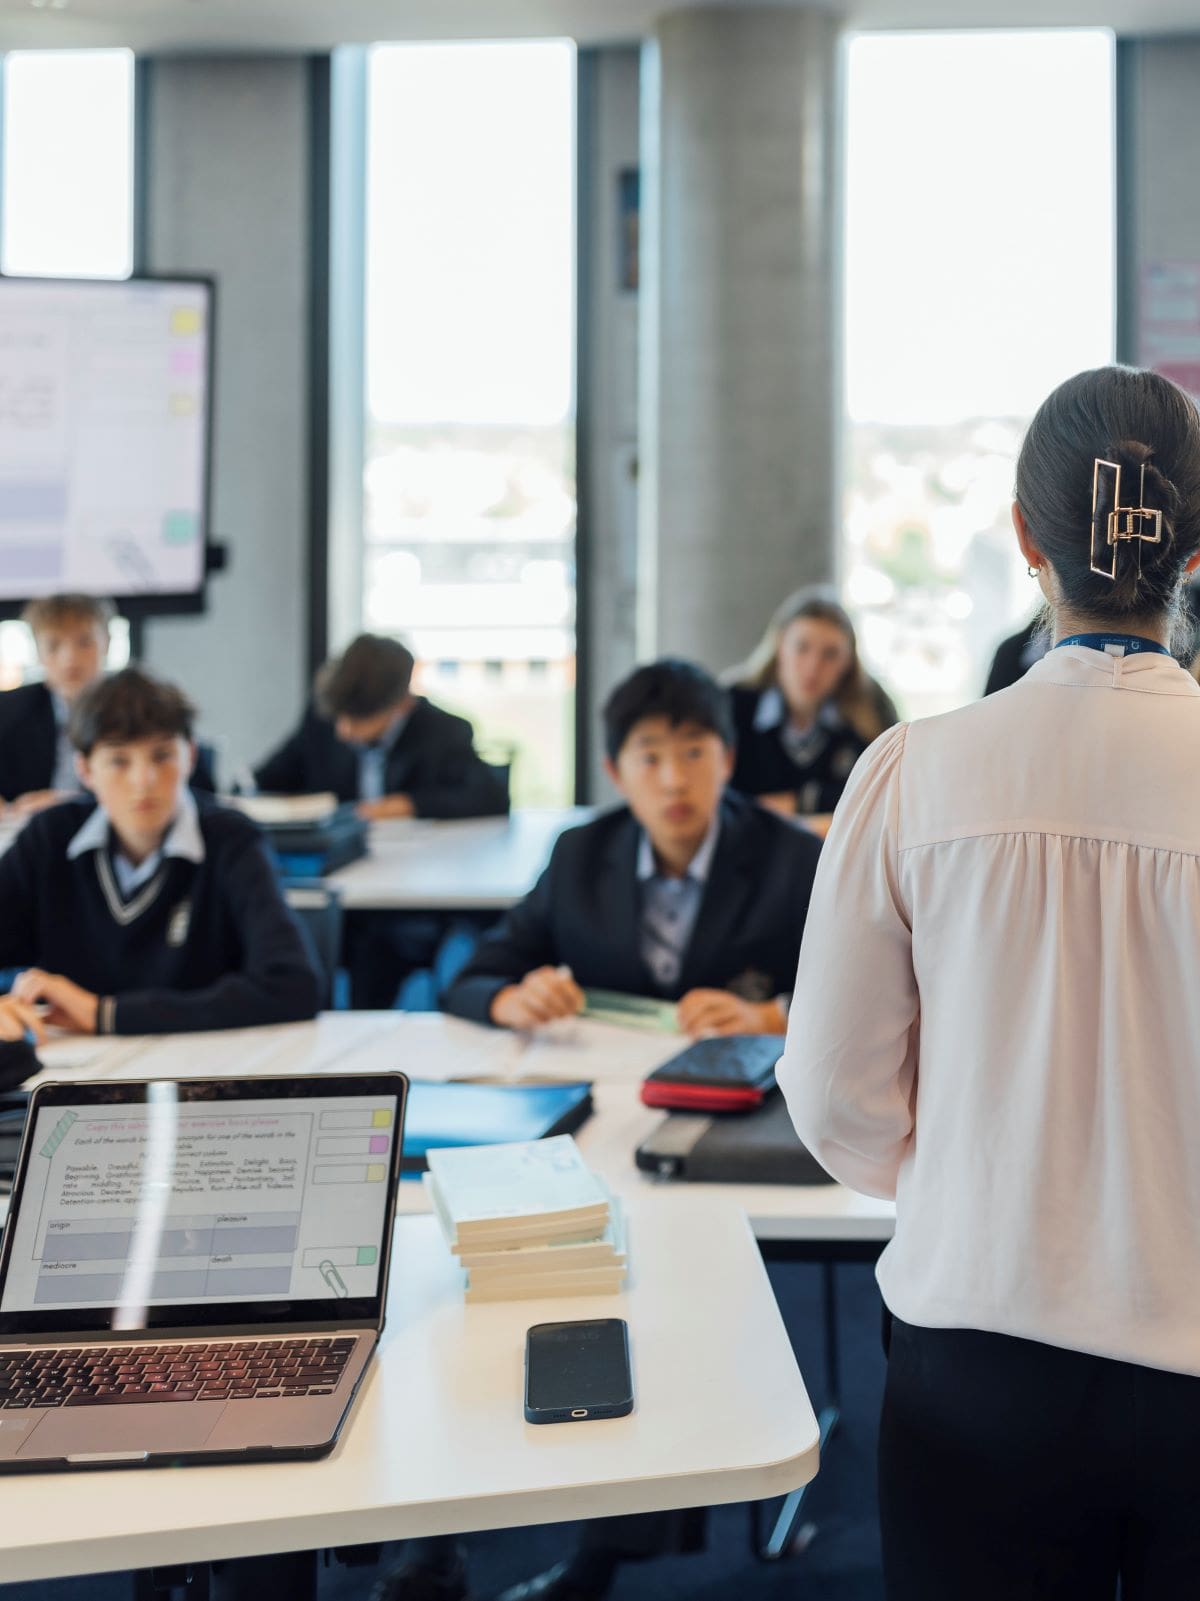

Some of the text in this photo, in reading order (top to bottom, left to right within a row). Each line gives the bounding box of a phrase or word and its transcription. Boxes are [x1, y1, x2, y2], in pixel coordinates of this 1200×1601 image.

[49, 1214, 248, 1230] origin pleasure
[42, 1254, 232, 1270] mediocre death
